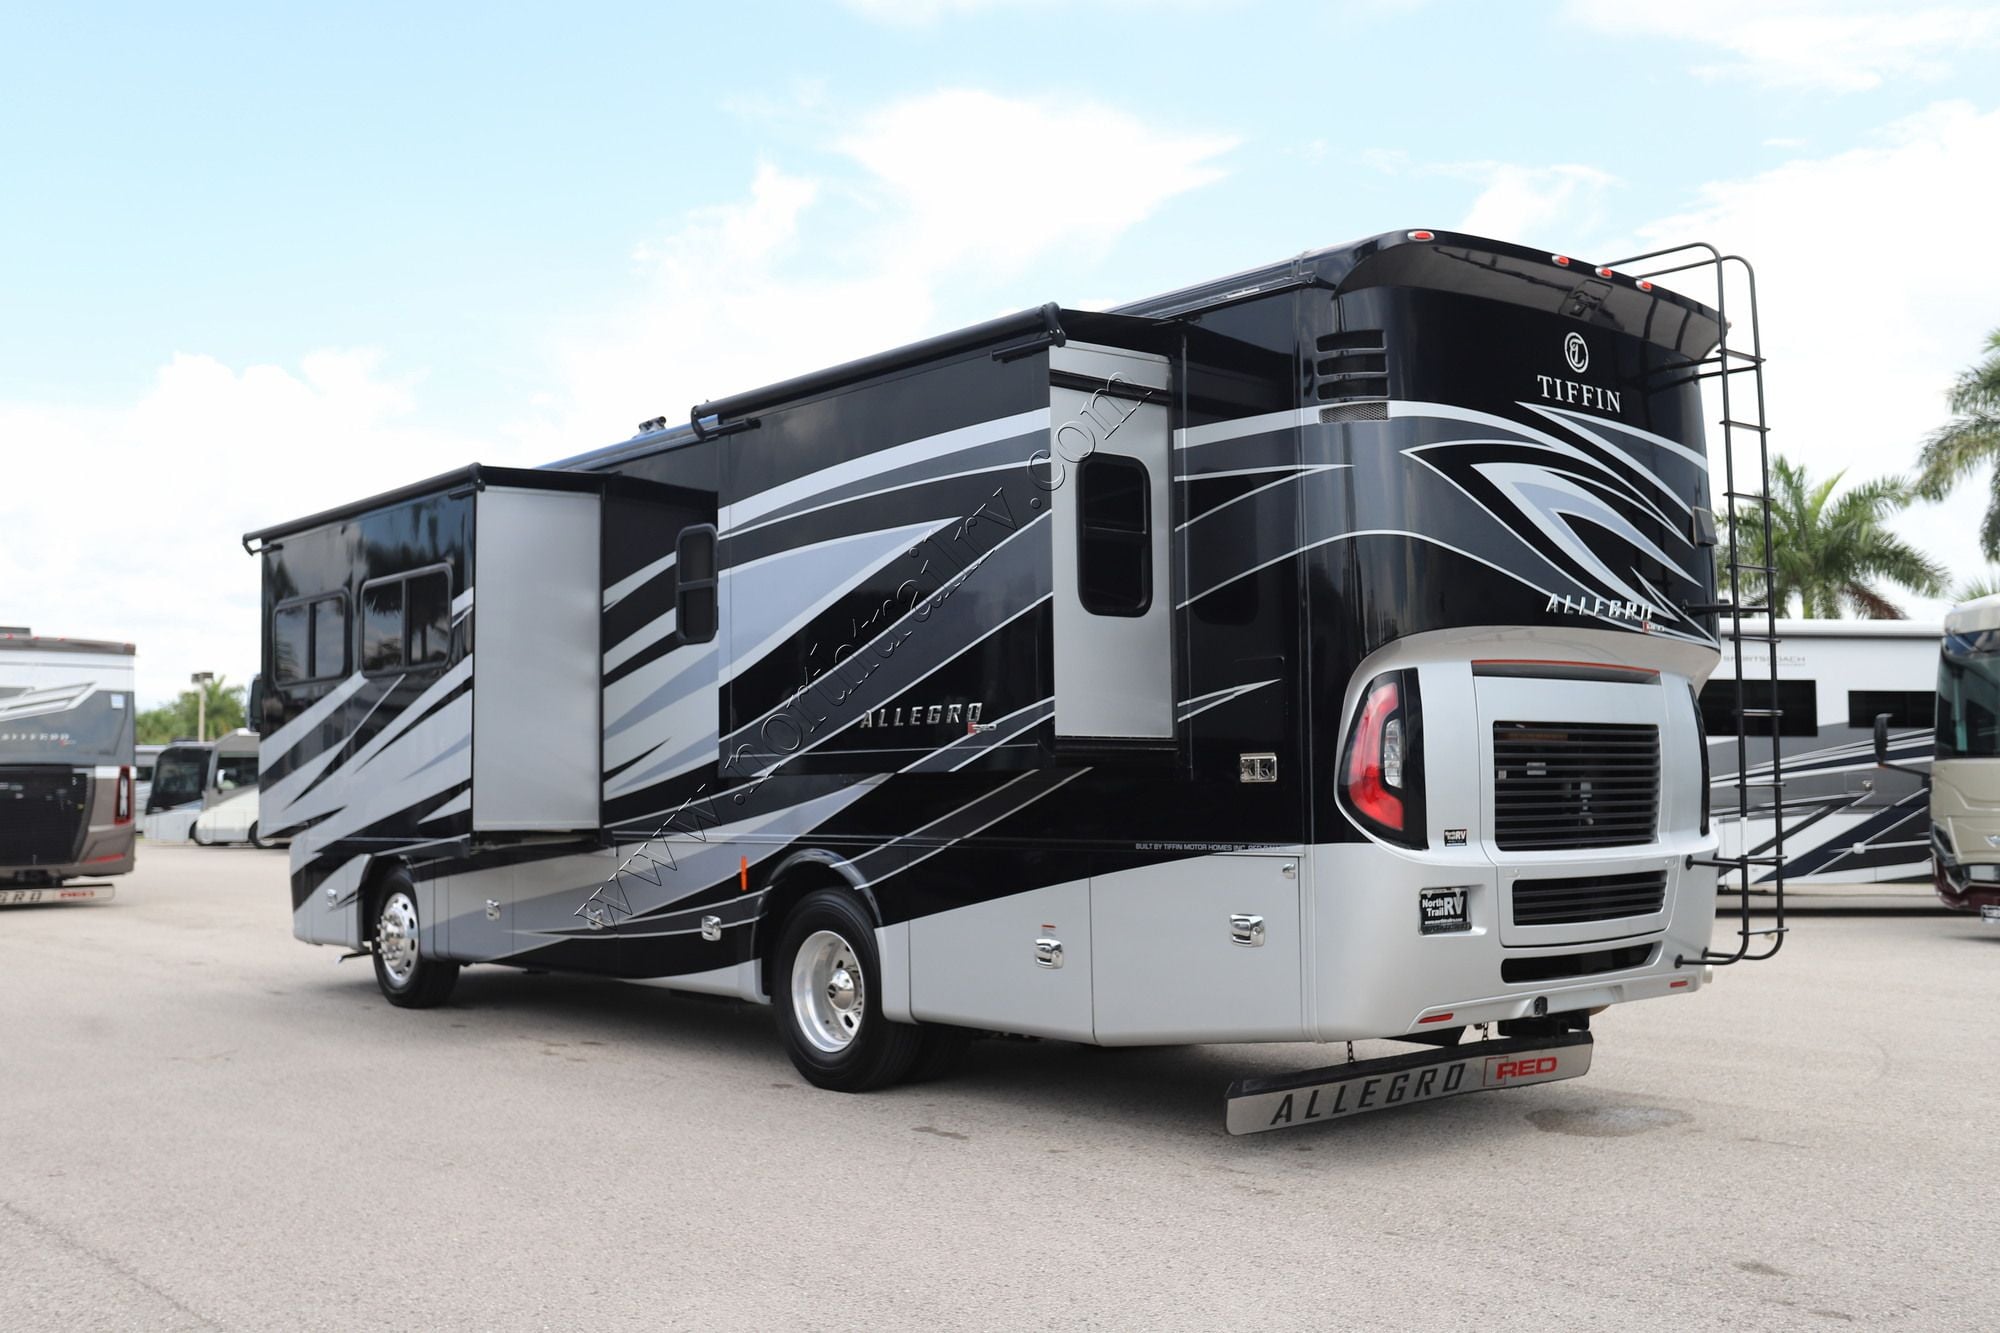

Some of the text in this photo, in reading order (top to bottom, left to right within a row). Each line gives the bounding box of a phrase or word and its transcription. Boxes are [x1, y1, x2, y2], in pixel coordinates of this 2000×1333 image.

[1537, 374, 1621, 414] TIFFIN
[1546, 593, 1652, 621] ALLEGRO
[860, 702, 983, 729] ALLEGRO
[1183, 843, 1207, 851] MOTOR
[1207, 844, 1233, 852] HOMES
[1422, 896, 1464, 915] North RV
[1426, 907, 1444, 917] Trail
[1270, 1056, 1558, 1126] ALLEGRO RED
